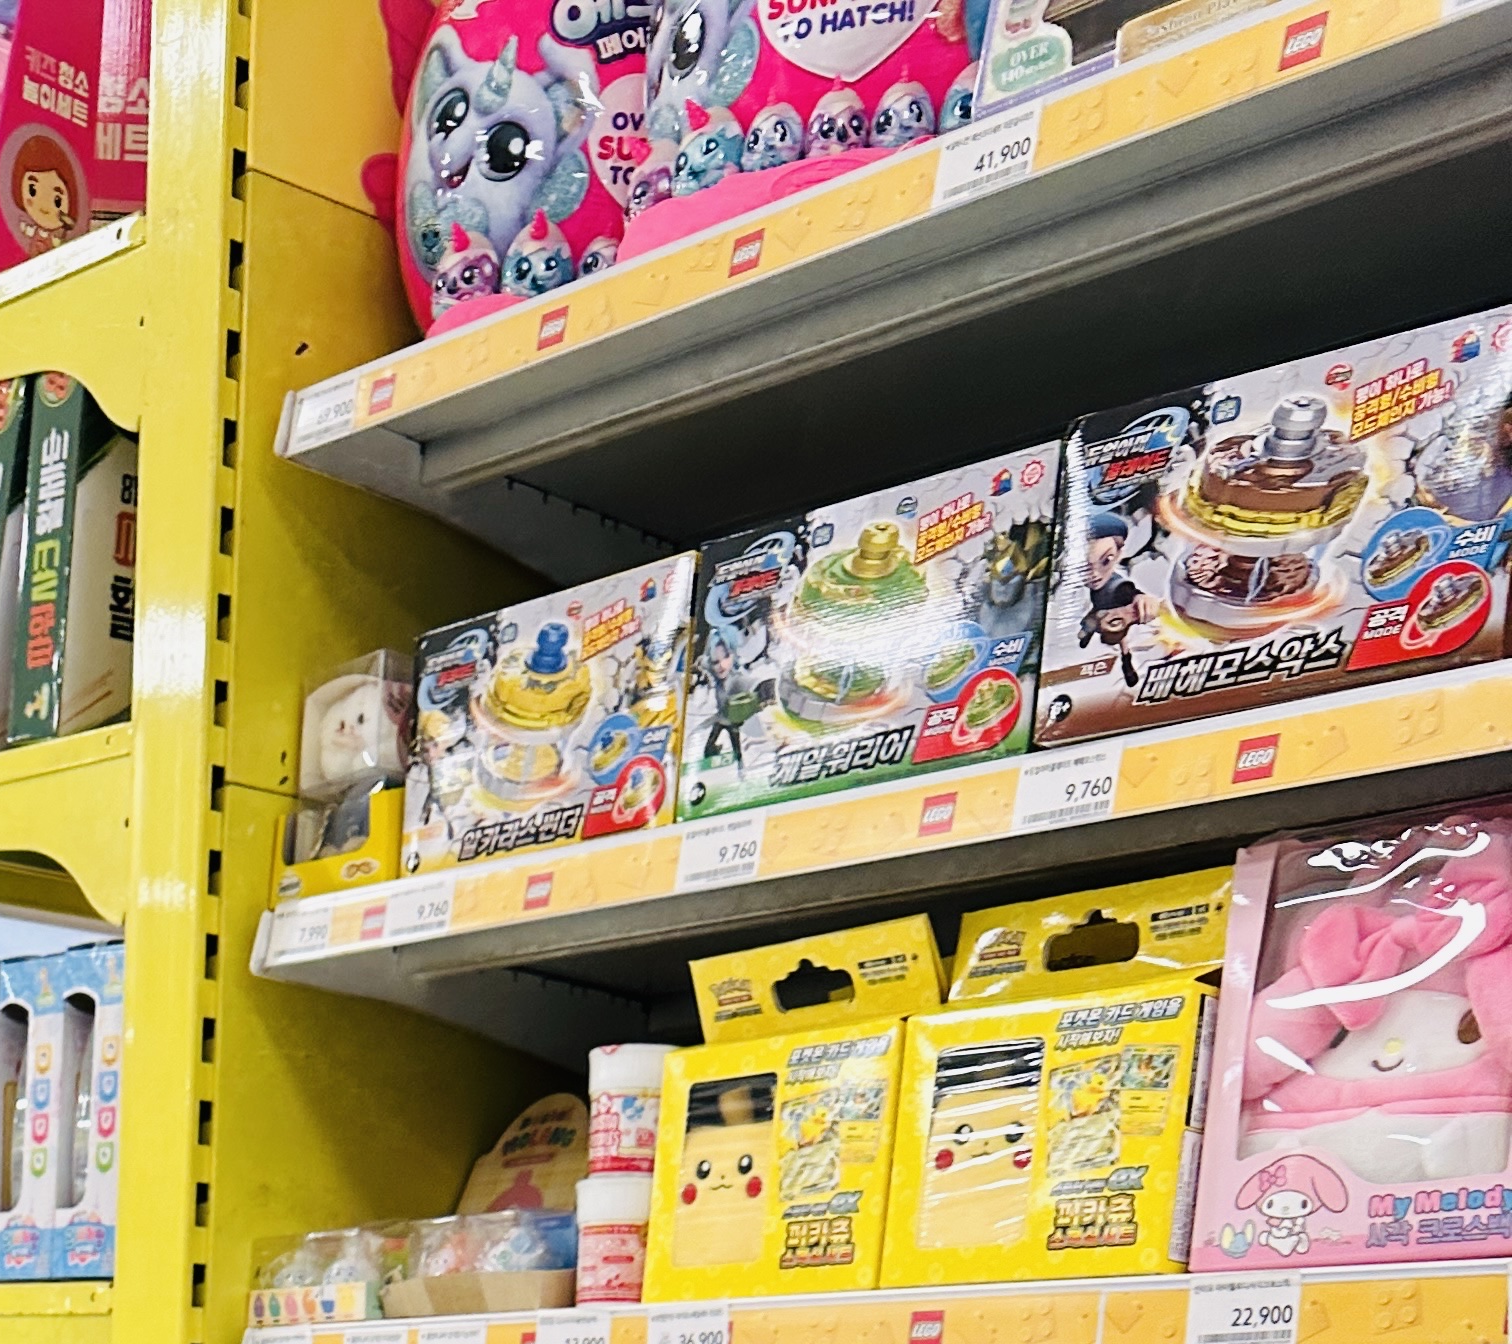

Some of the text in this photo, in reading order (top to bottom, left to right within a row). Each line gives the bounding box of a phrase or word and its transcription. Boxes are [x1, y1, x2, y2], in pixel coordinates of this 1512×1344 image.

[975, 137, 1032, 174] 41,900
[1452, 527, 1497, 550] 수비
[1448, 543, 1490, 560] MODE
[1367, 604, 1409, 626] 공격
[1363, 625, 1403, 641] MODE
[992, 638, 1024, 658] 수비
[1237, 745, 1278, 769] LEGO
[1064, 776, 1113, 802] 9,760
[718, 840, 758, 863] 9,760
[1104, 1002, 1136, 1023] 카드
[1368, 1186, 1512, 1222] My Melody
[1366, 1220, 1414, 1248] 사각
[1230, 1303, 1294, 1330] 22,900
